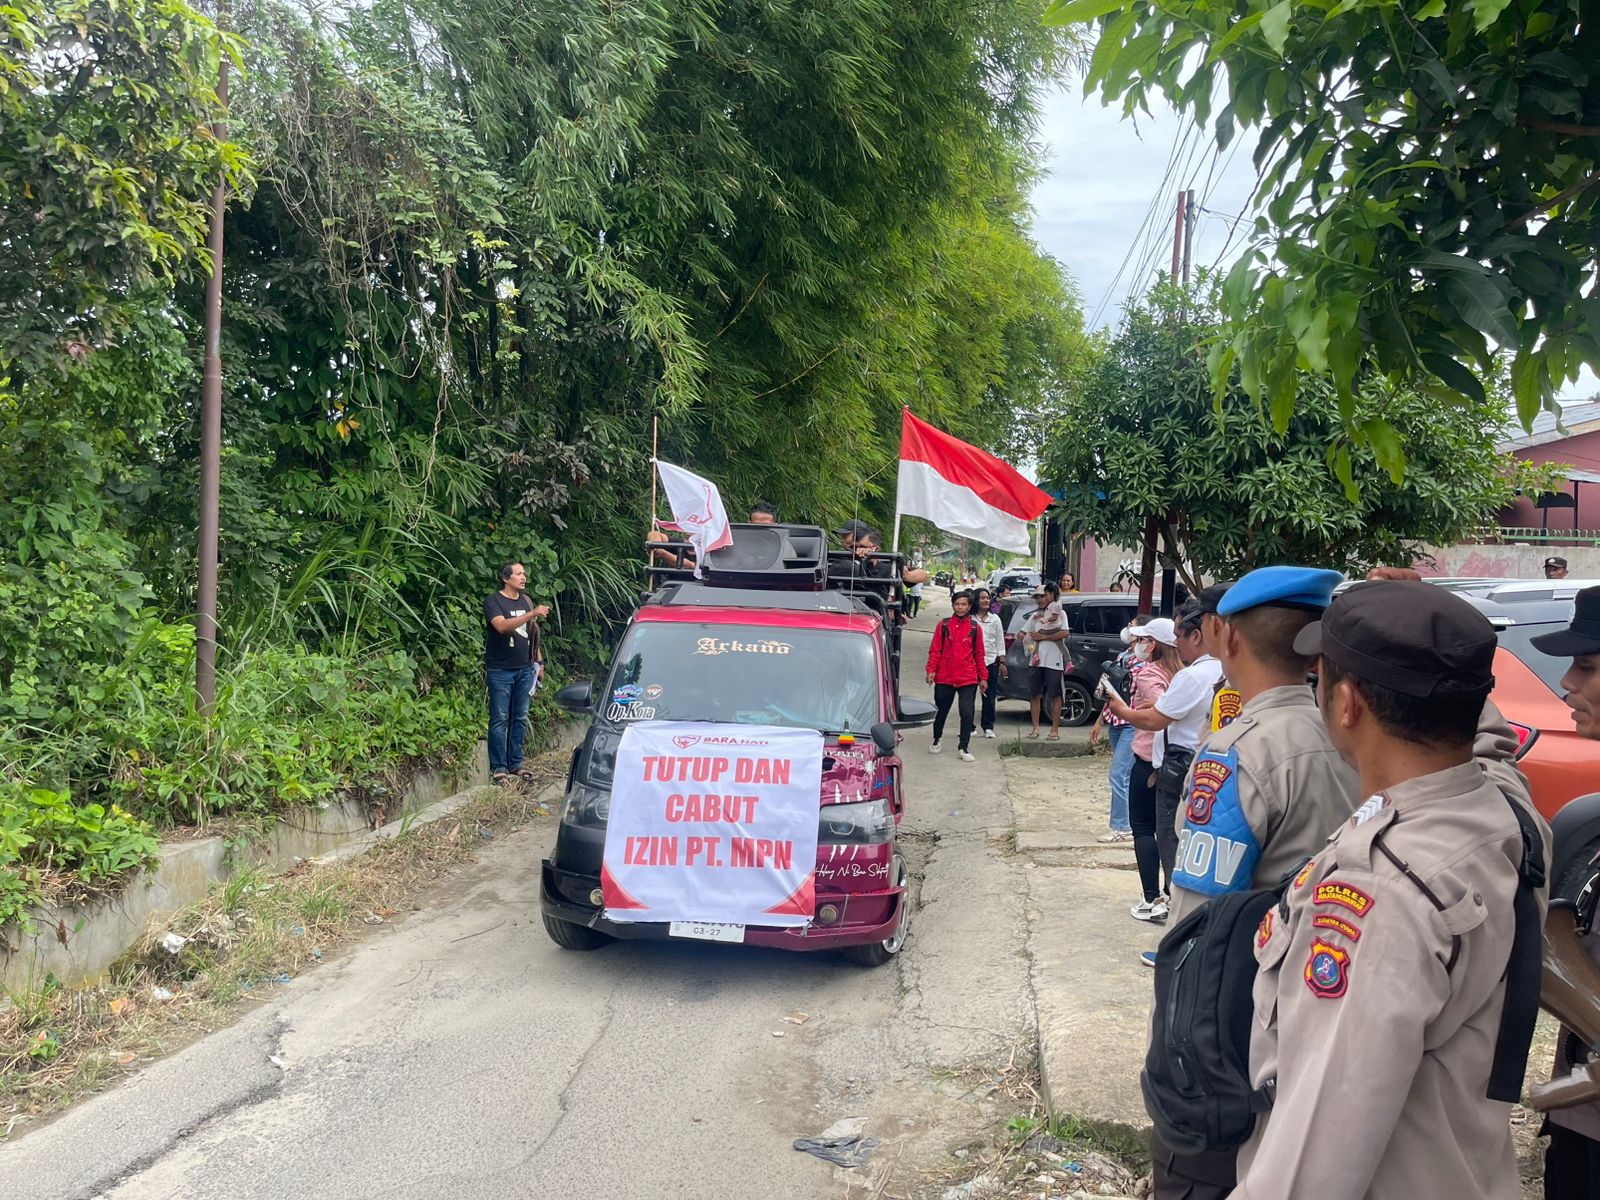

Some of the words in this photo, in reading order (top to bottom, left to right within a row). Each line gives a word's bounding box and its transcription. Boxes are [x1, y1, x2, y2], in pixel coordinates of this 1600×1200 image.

[703, 736, 738, 745] BARA
[643, 756, 729, 782] TUTUP
[735, 758, 791, 785] DAN
[665, 794, 760, 824] CABUT
[624, 836, 678, 866] IZIN
[685, 836, 723, 867] PT.
[730, 838, 792, 870] MPN
[1318, 885, 1367, 906] POLRES
